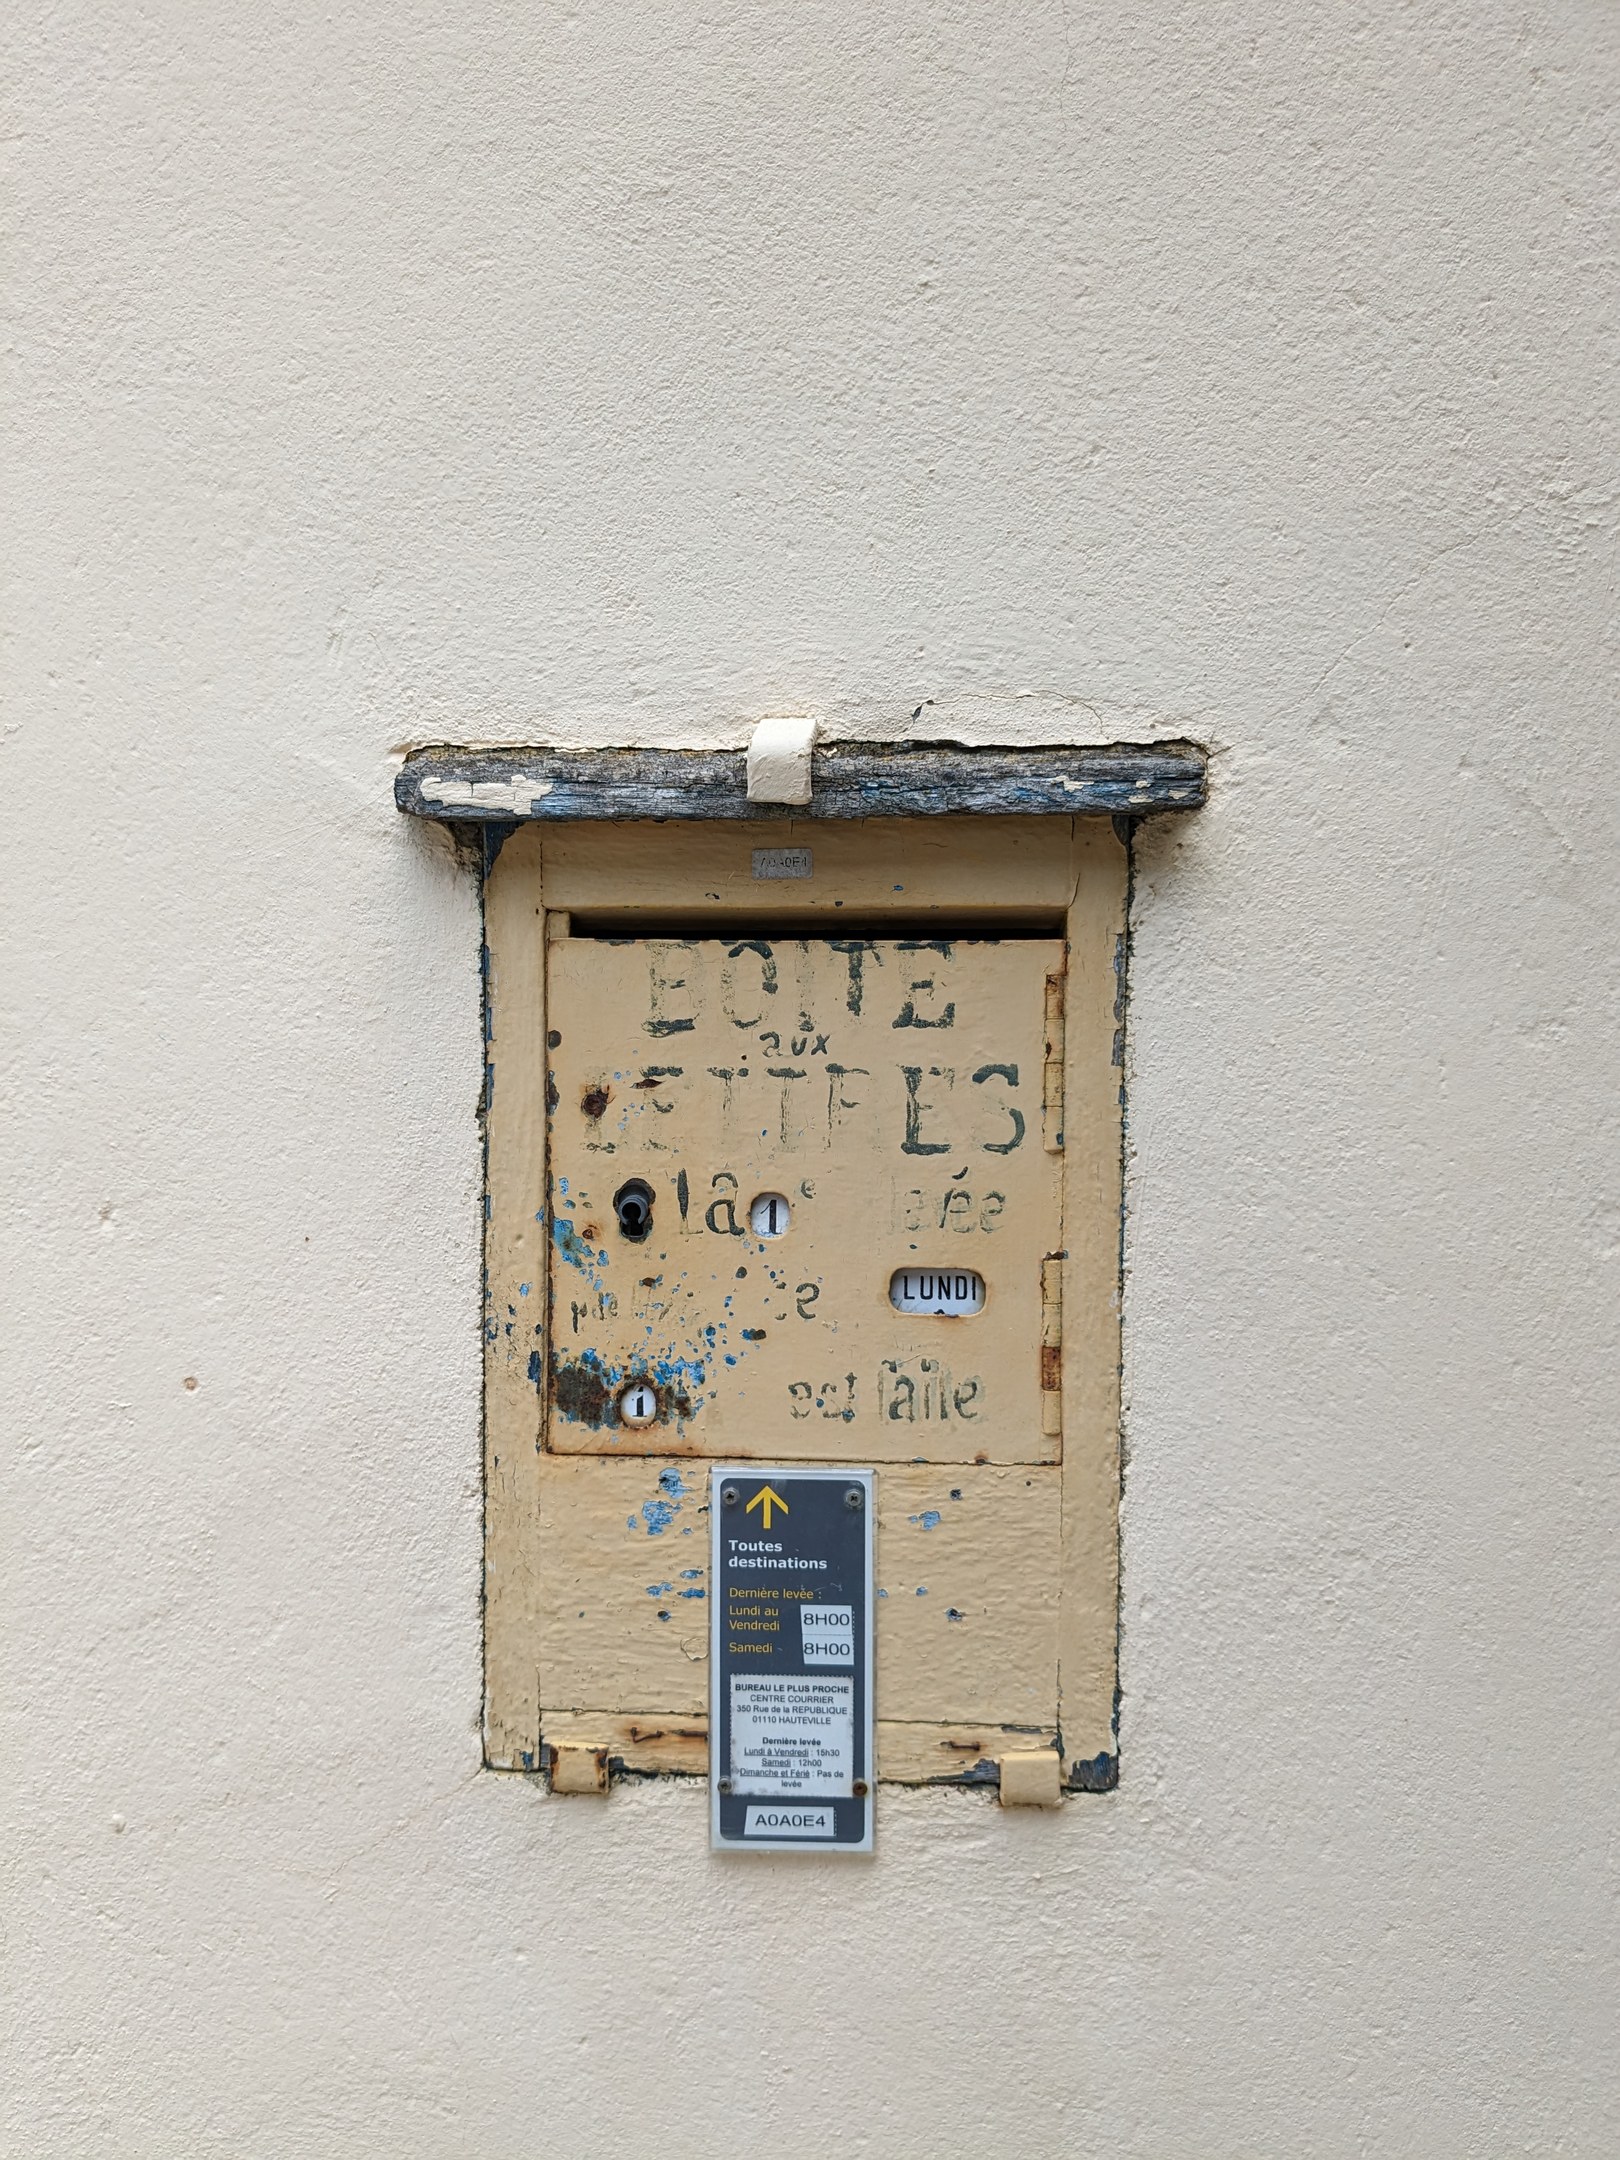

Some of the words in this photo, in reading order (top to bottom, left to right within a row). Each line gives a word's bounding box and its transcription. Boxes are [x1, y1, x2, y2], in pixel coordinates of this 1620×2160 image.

[760, 1031, 830, 1057] aux
[904, 1276, 976, 1300] LUNDI
[728, 1540, 783, 1552] Toutes
[728, 1556, 828, 1569] destinations
[729, 1587, 779, 1598] Dernière
[783, 1588, 814, 1599] levée
[729, 1606, 760, 1616] Lundi
[764, 1607, 778, 1616] au
[803, 1613, 850, 1626] 8H00
[729, 1620, 780, 1630] Vendredi
[729, 1642, 773, 1653] Samedi
[804, 1643, 850, 1655] 8H00
[735, 1684, 771, 1692] BUREAU
[812, 1685, 849, 1693] PROCHE
[750, 1694, 785, 1702] CENTRE
[788, 1695, 834, 1703] COURRIER
[753, 1705, 769, 1713] Rue
[792, 1706, 847, 1715] REPUBLIQUE
[779, 1716, 831, 1724] HAUTEVILLE
[762, 1737, 797, 1745] Dernière
[744, 1747, 765, 1756] Lundi
[774, 1748, 808, 1757] Vendredi
[762, 1758, 791, 1767] Samedi
[740, 1768, 778, 1777] Dimanche
[791, 1769, 810, 1778] Férié
[755, 1814, 825, 1827] A0A0E4
